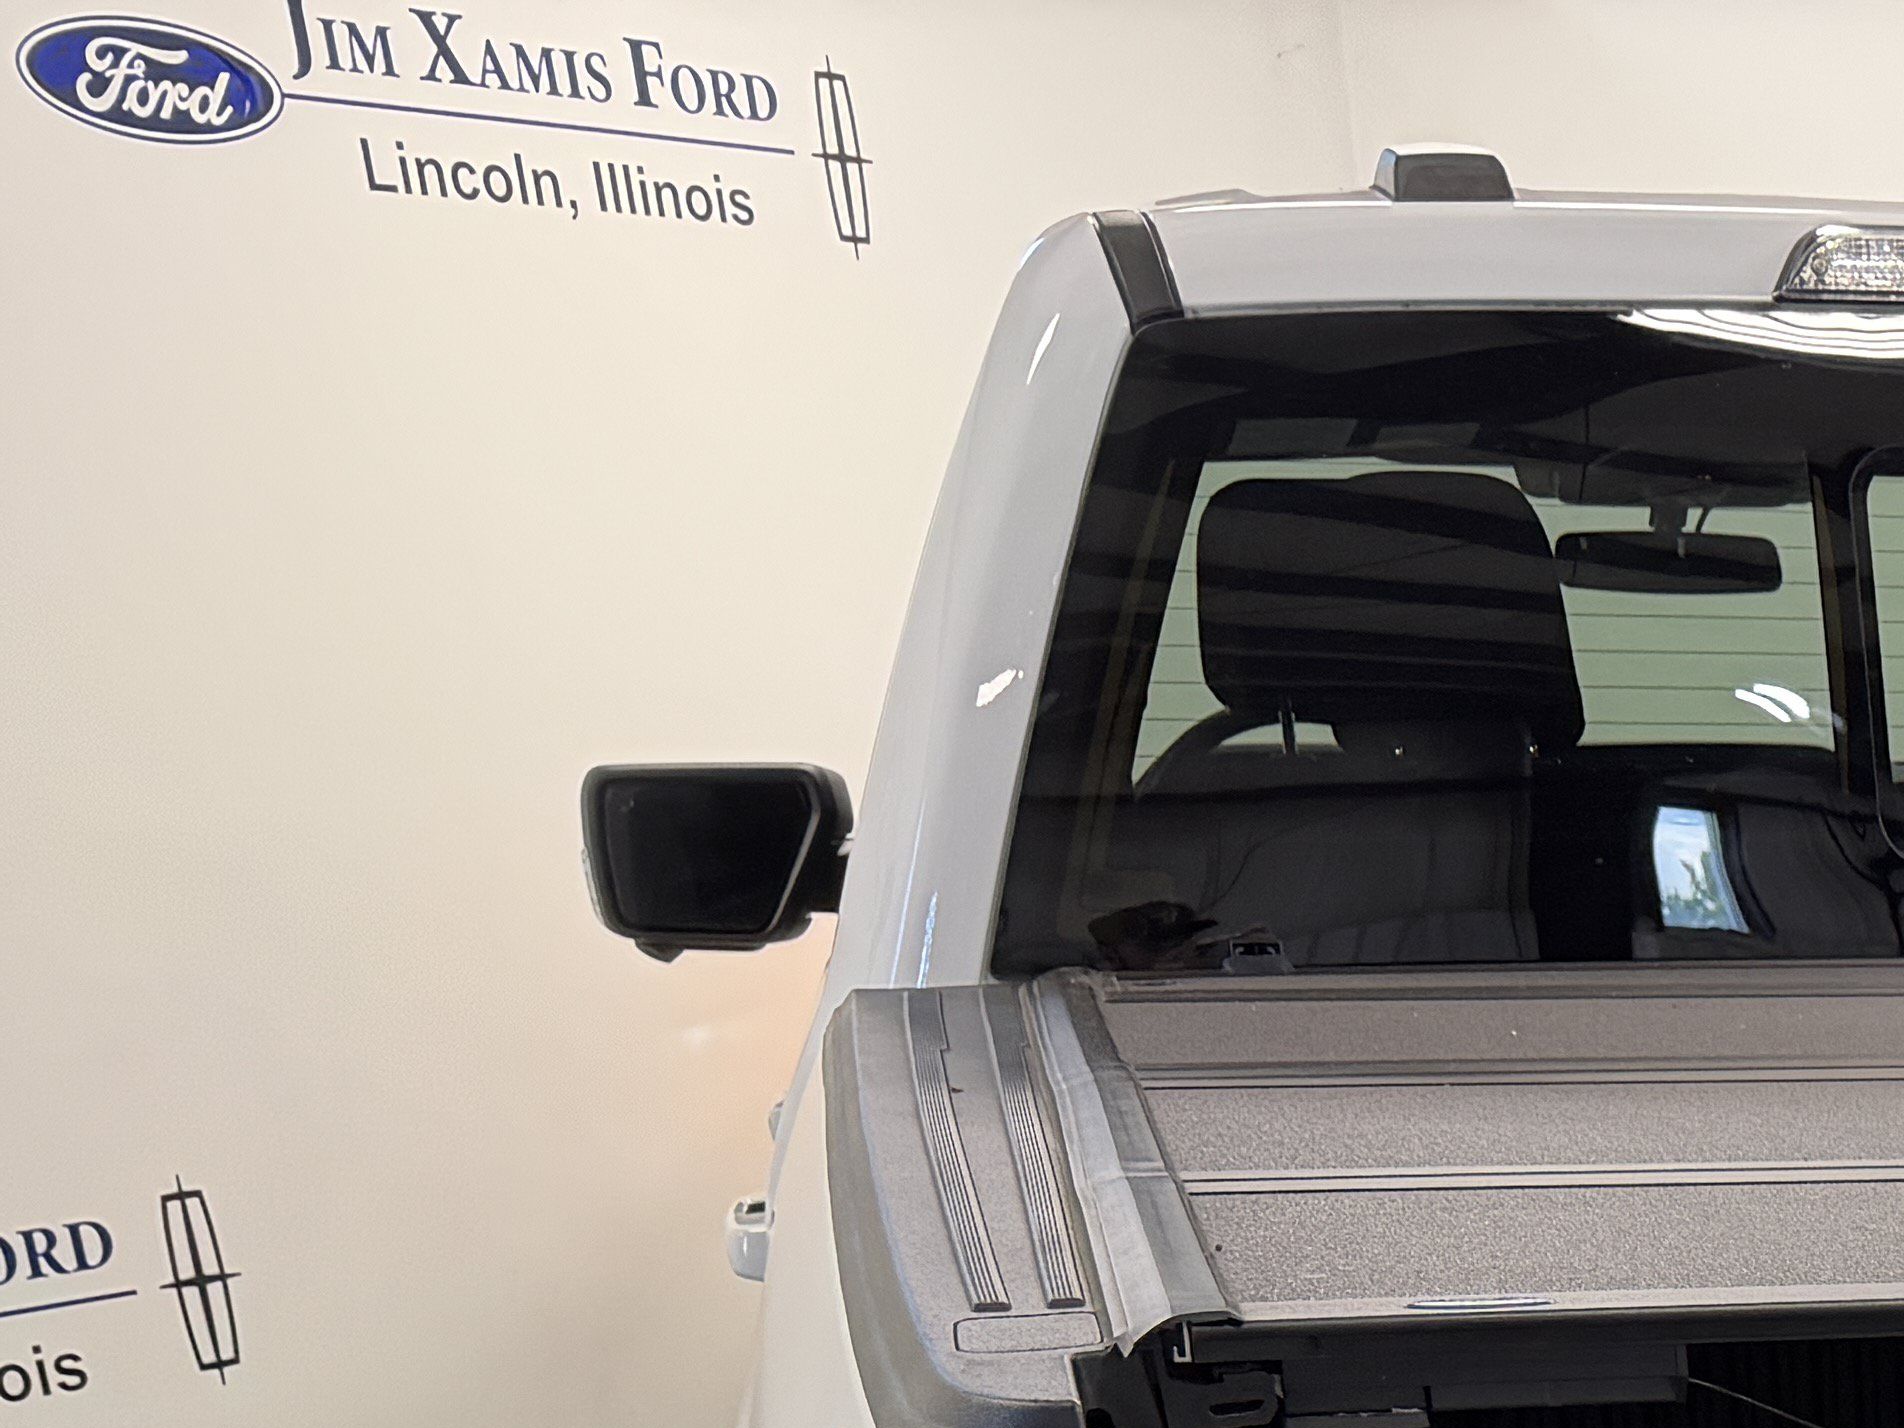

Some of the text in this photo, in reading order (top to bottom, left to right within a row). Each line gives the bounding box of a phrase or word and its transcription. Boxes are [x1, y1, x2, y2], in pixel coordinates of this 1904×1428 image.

[76, 36, 234, 127] Ford
[284, 0, 778, 122] JIM XAMIS FORD
[359, 137, 755, 226] Lincoln, Illinois
